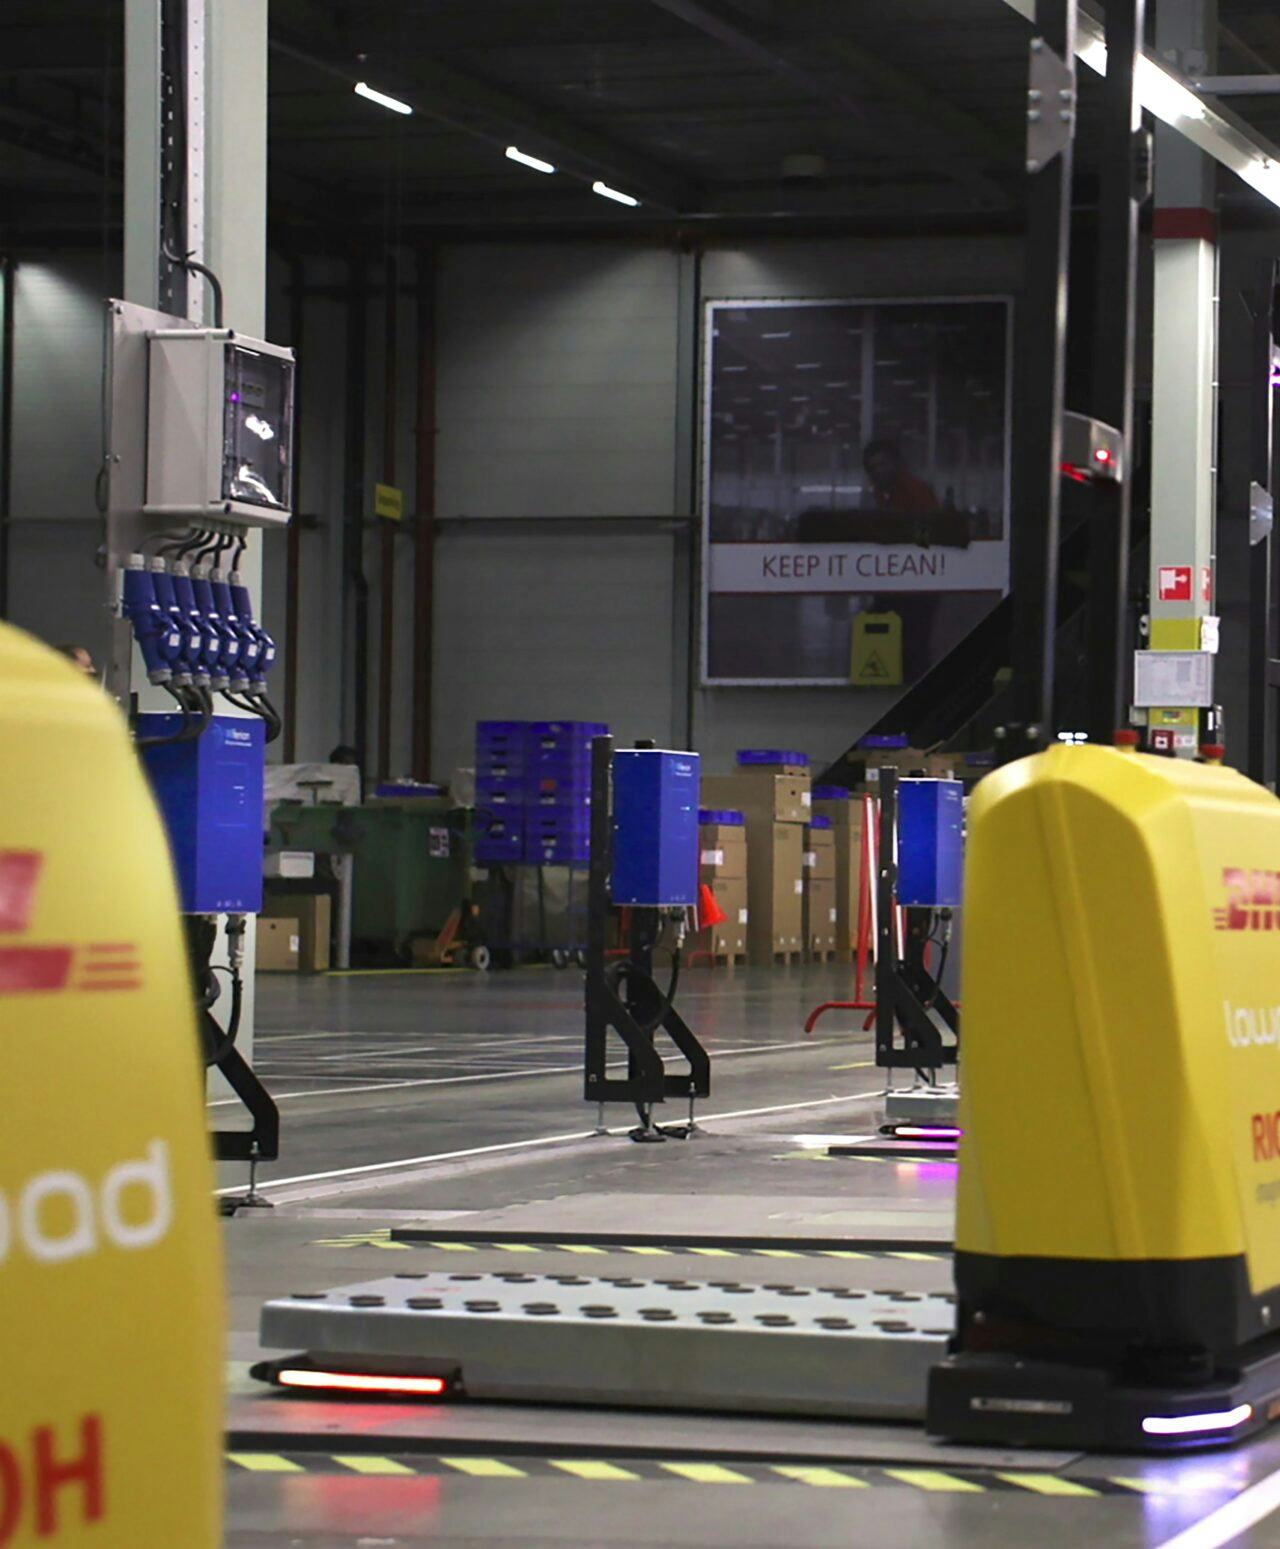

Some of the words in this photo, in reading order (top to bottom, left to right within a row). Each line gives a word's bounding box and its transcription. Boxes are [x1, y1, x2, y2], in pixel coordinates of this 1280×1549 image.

[762, 555, 820, 578] KEEP
[828, 554, 848, 577] IT
[856, 553, 946, 577] CLEAN!
[0, 1138, 173, 1265] ad
